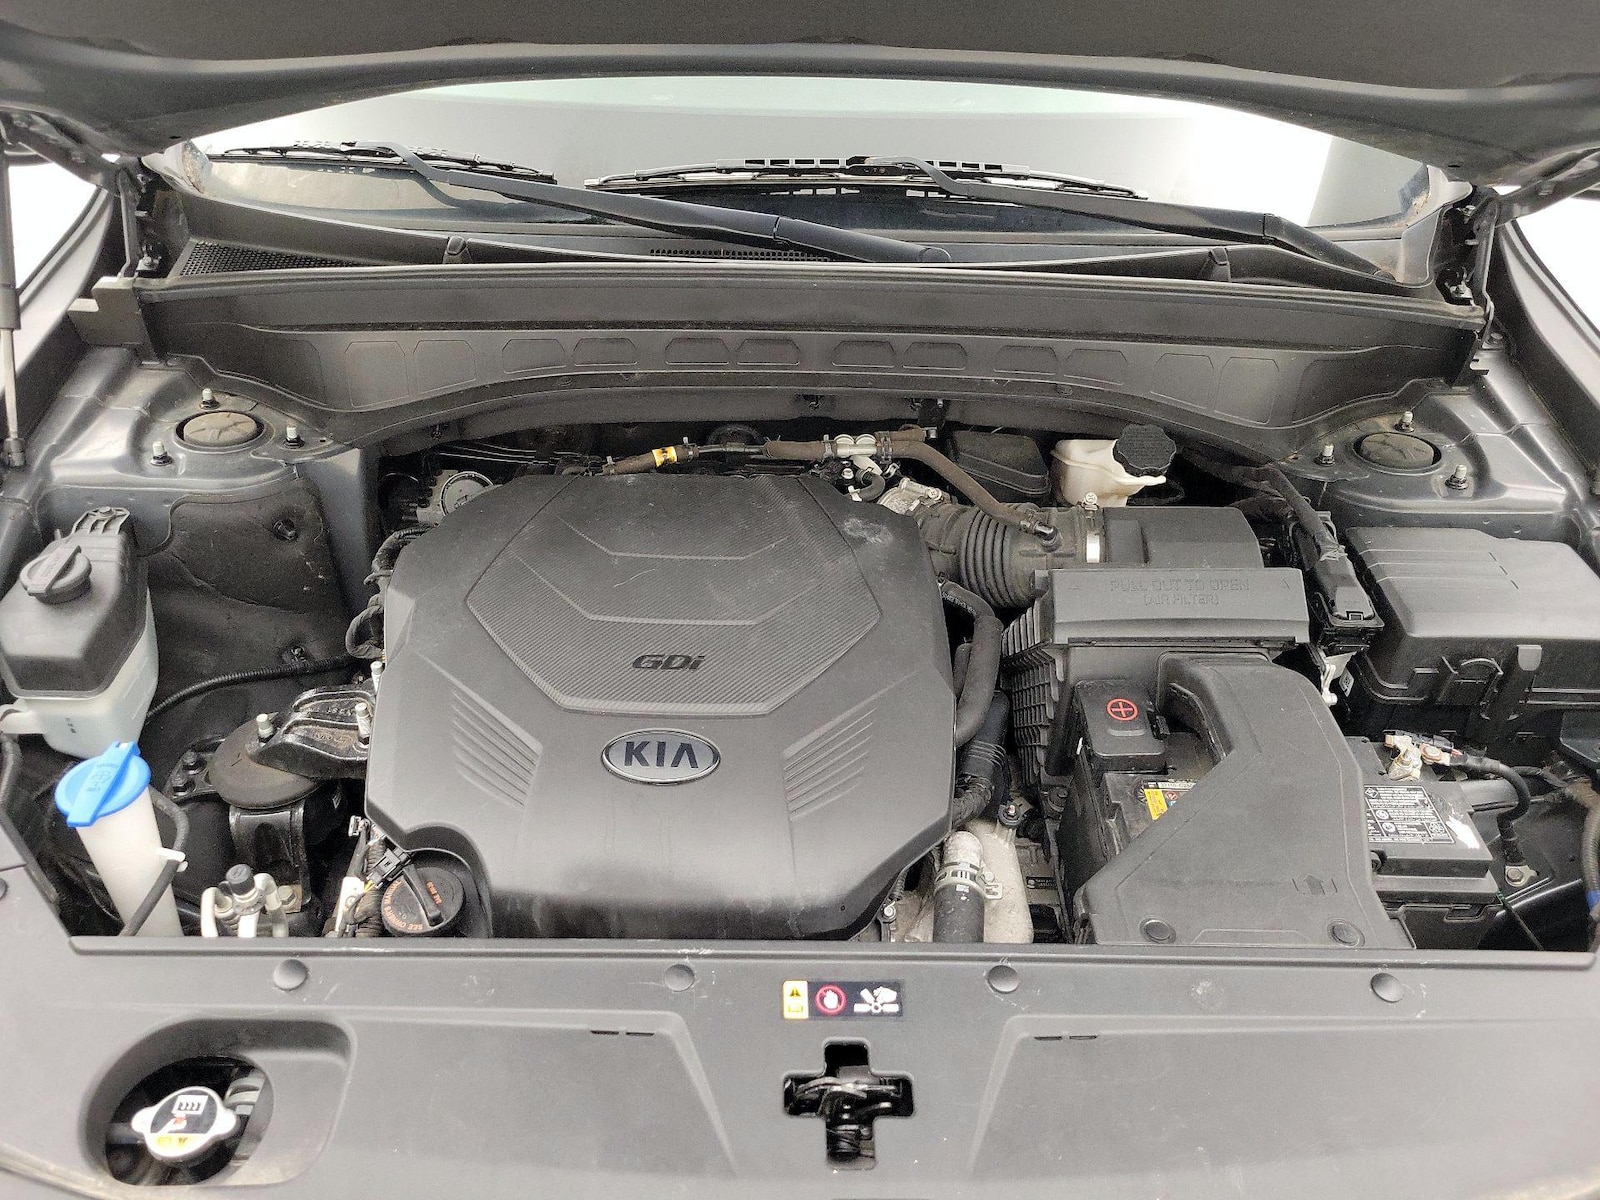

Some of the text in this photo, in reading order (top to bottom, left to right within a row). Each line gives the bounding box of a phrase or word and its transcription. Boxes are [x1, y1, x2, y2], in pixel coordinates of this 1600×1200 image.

[1110, 578, 1250, 592] PULL OUT TO OPEN
[633, 654, 706, 670] GDi
[624, 740, 699, 769] KIA
